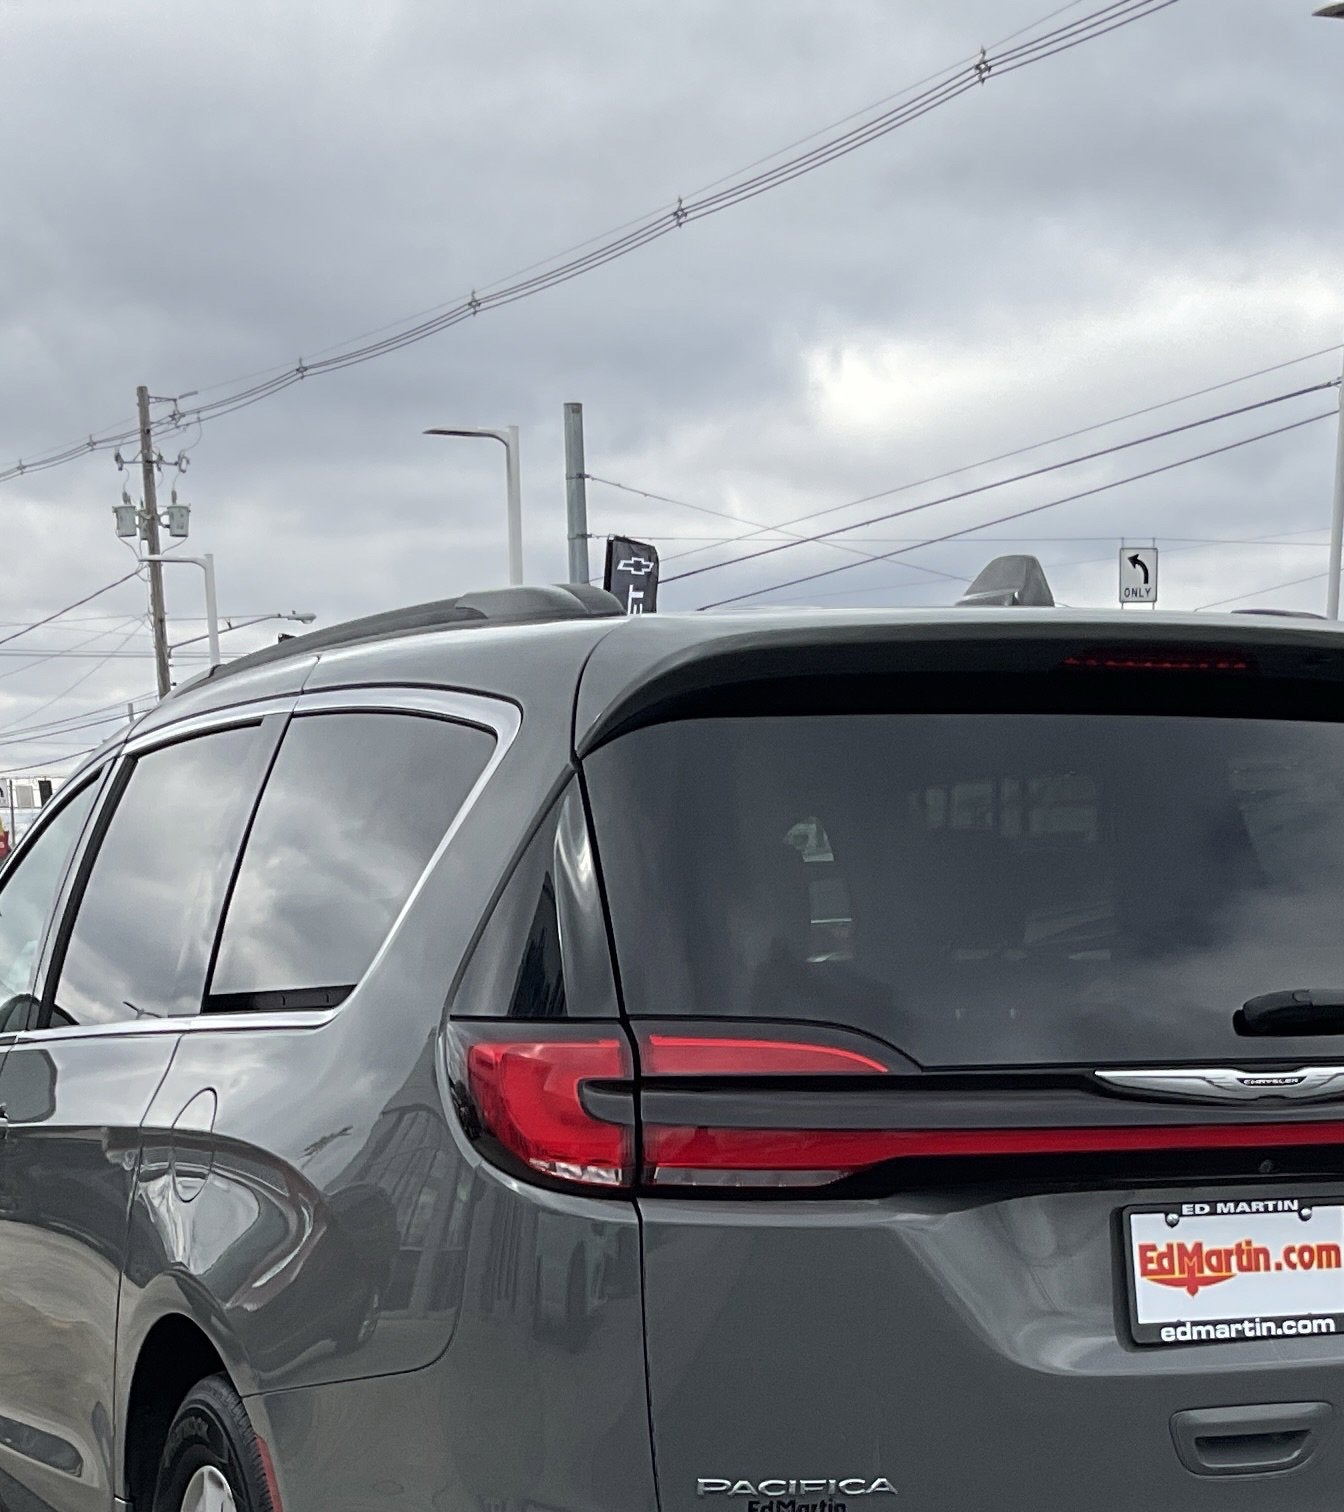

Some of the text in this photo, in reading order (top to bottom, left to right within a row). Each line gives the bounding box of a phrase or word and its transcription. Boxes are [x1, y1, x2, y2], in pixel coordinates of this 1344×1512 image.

[1123, 587, 1152, 599] ONLY
[1182, 1199, 1299, 1216] ED MARTIN
[1160, 1317, 1336, 1342] edmartin.com
[697, 1478, 898, 1497] PACIFICA
